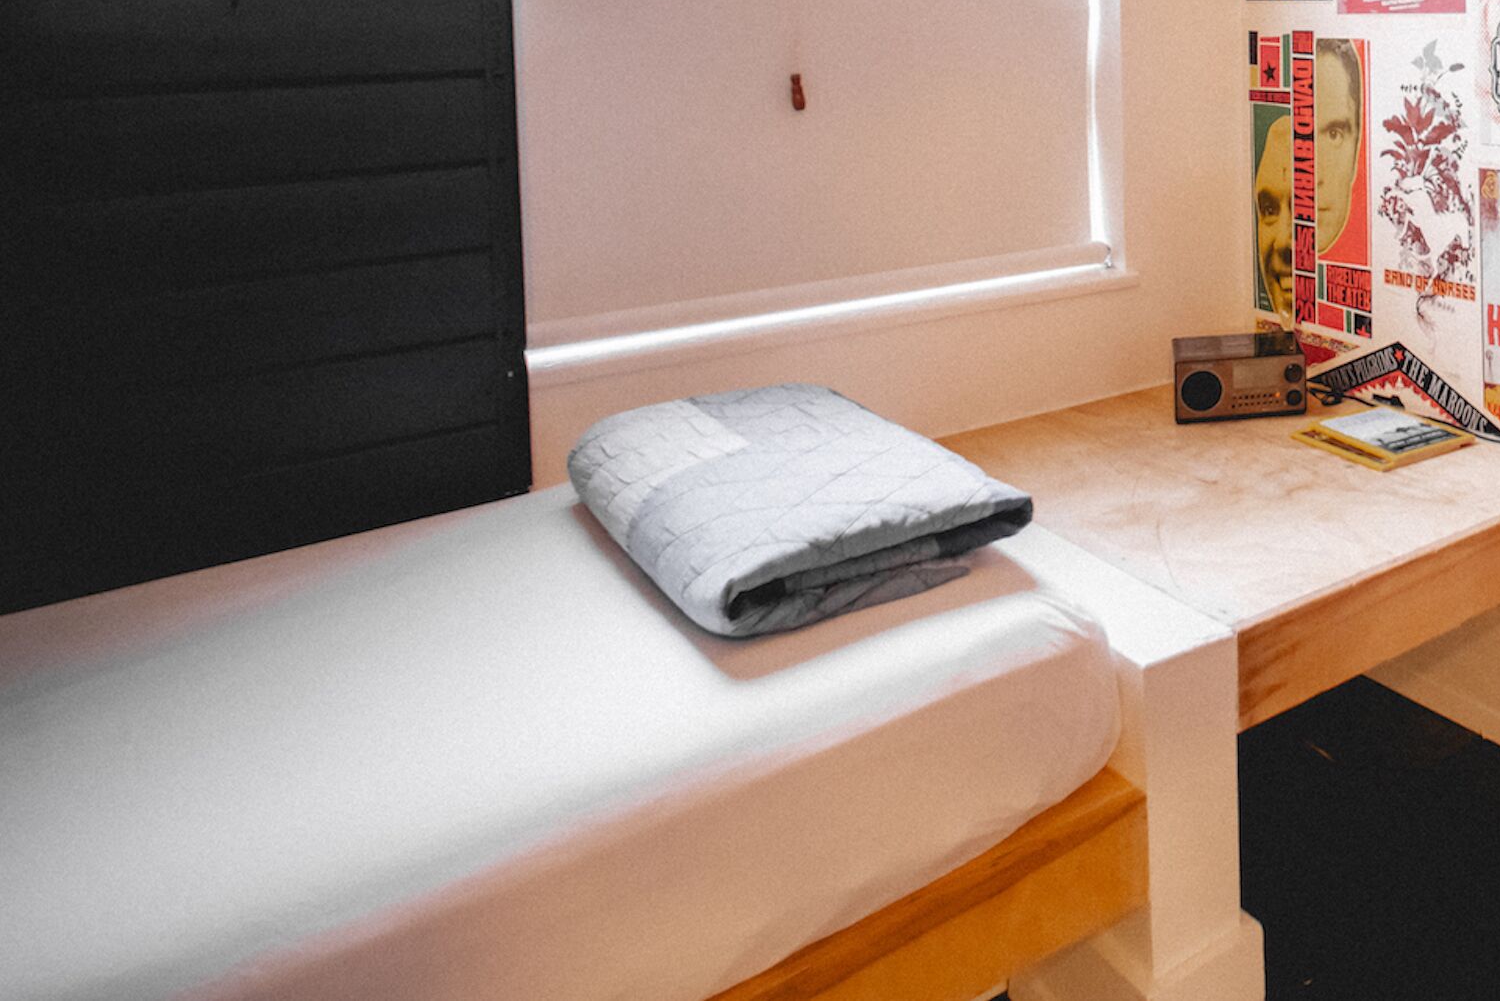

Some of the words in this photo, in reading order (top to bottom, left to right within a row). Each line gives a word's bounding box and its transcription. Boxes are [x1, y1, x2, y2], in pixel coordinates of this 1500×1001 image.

[1384, 269, 1413, 288] BAND
[1415, 275, 1430, 292] OF
[1432, 279, 1476, 302] HORSES
[1403, 349, 1430, 387] THE
[1428, 371, 1489, 435] MAROONS
